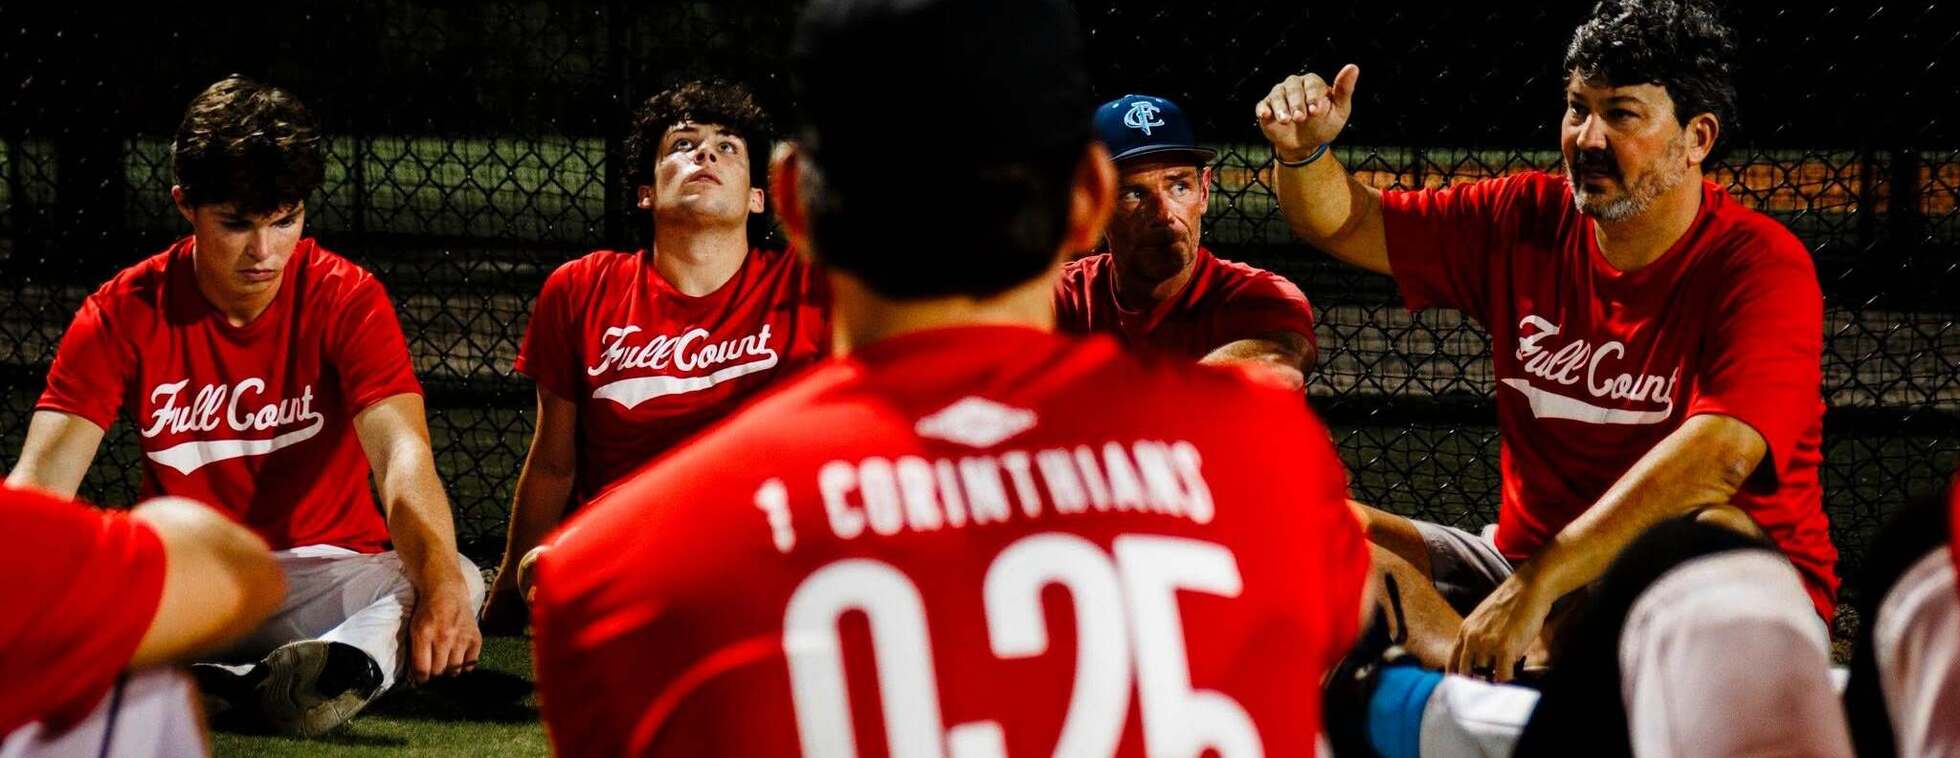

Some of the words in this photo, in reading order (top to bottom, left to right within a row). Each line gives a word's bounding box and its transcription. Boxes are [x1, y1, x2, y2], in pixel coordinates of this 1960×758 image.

[587, 325, 678, 377] Full
[673, 323, 778, 371] Count
[1515, 314, 1591, 385] Full
[1587, 341, 1679, 404] Count
[141, 377, 227, 438] Full
[226, 377, 318, 431] Count
[755, 477, 796, 554] 1
[817, 439, 1216, 539] CORINTHIANS
